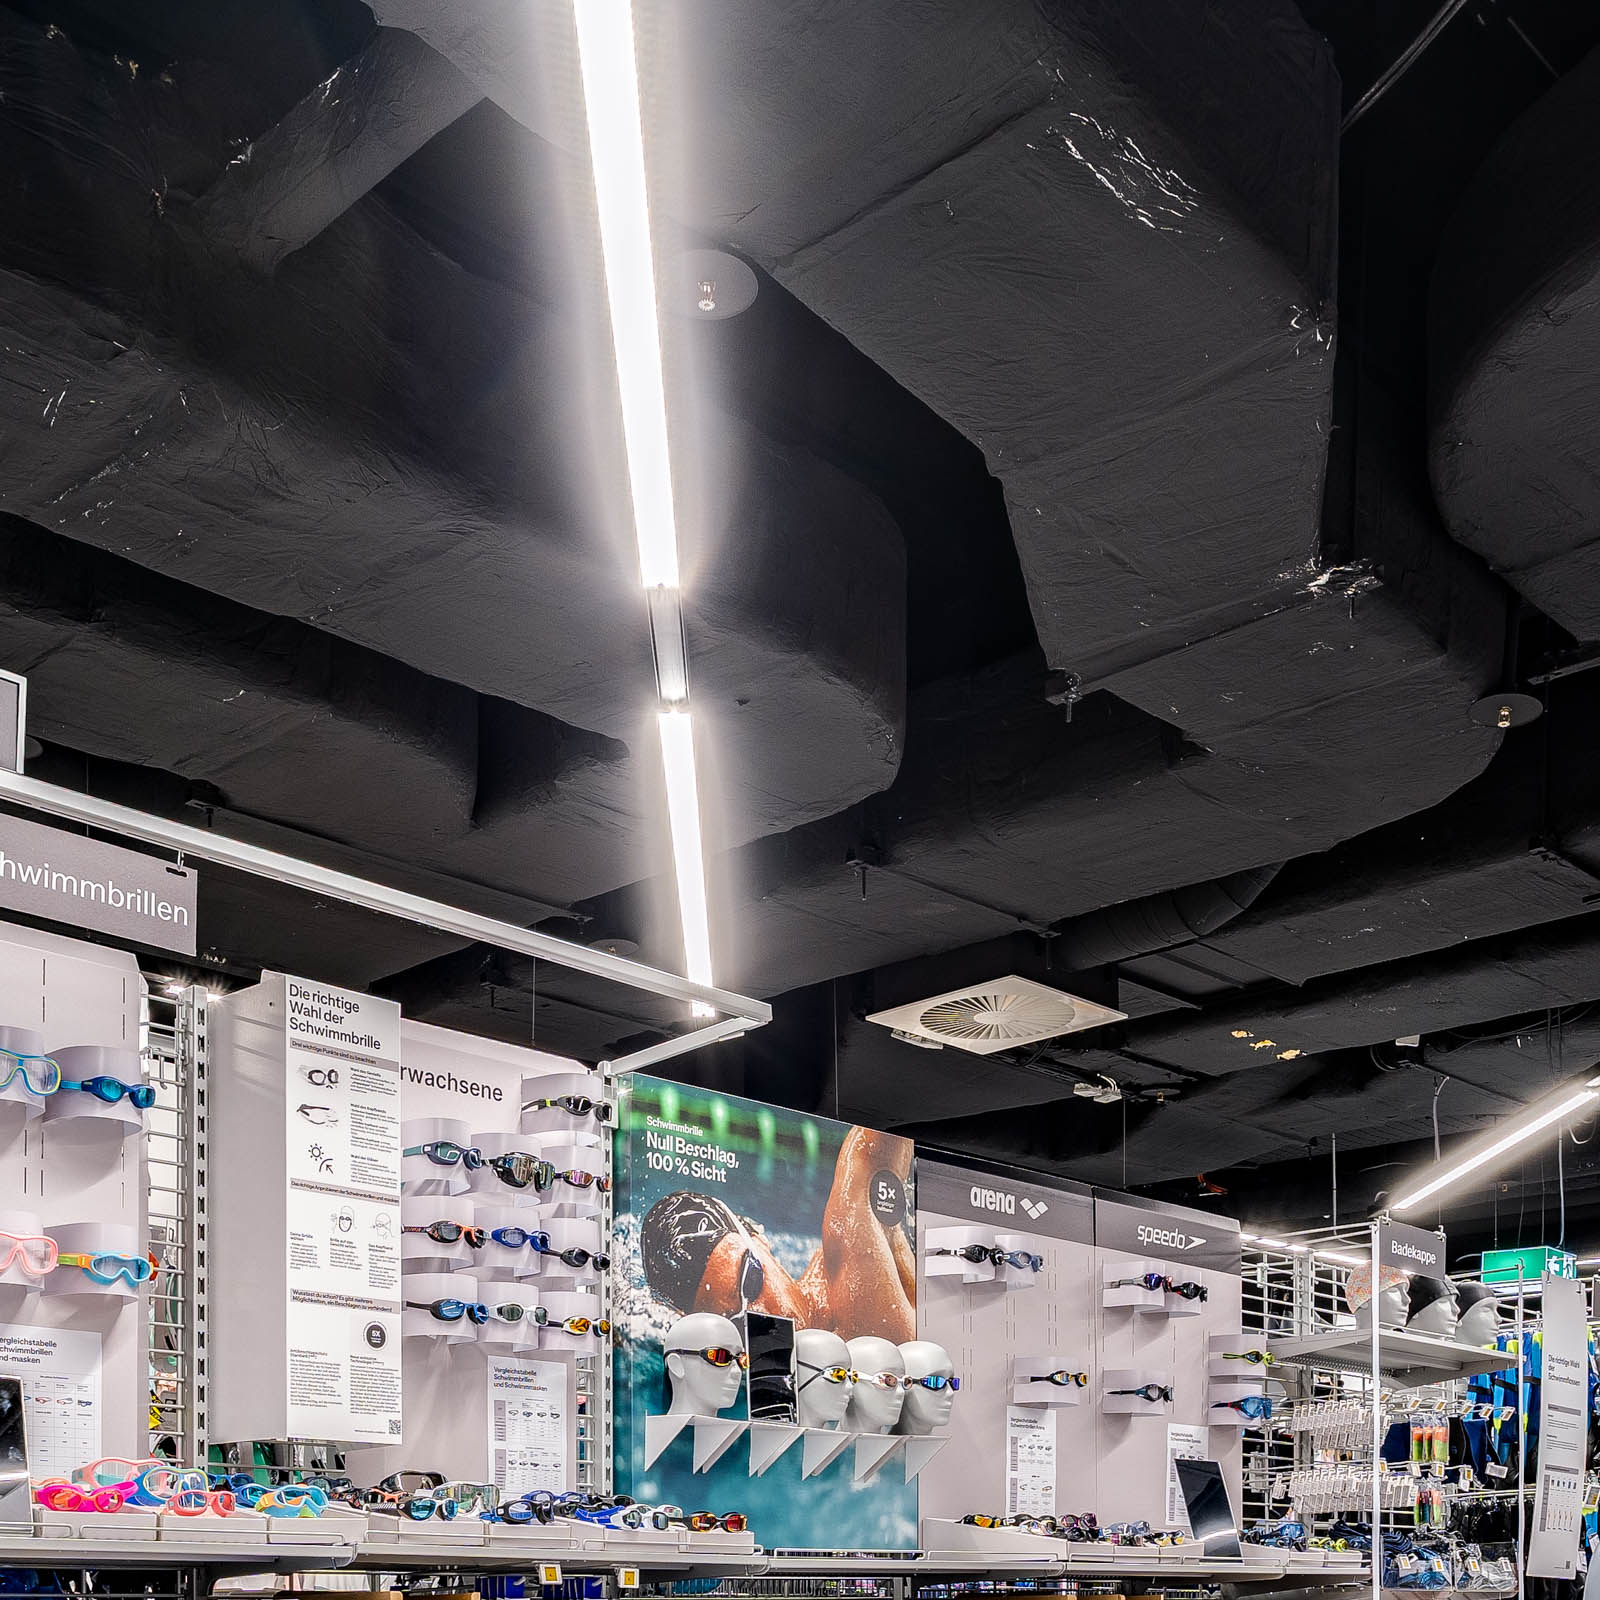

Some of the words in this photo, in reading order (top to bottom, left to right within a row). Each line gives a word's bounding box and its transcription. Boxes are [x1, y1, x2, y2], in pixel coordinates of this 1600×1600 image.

[289, 983, 310, 1000] Die
[312, 990, 360, 1014] richtige
[290, 999, 322, 1020] Wahl
[324, 1010, 345, 1025] der
[289, 1016, 381, 1050] Schwimmbrille
[292, 1040, 302, 1048] Drei
[302, 1043, 322, 1053] wichtige
[400, 1063, 504, 1102] rwachsene
[646, 1115, 703, 1137] Schwimmbrille
[645, 1130, 674, 1154] Null
[675, 1135, 740, 1169] Beschlag,
[645, 1151, 673, 1173] 100
[676, 1156, 690, 1176] %
[691, 1158, 727, 1183] Sicht
[877, 1181, 896, 1200] 5x
[970, 1185, 1016, 1216] arena
[1137, 1223, 1186, 1251] speedo
[1391, 1239, 1436, 1266] Badekappe
[493, 1366, 537, 1377] Vergleichstabelle
[493, 1373, 535, 1383] Schwimmbrillen
